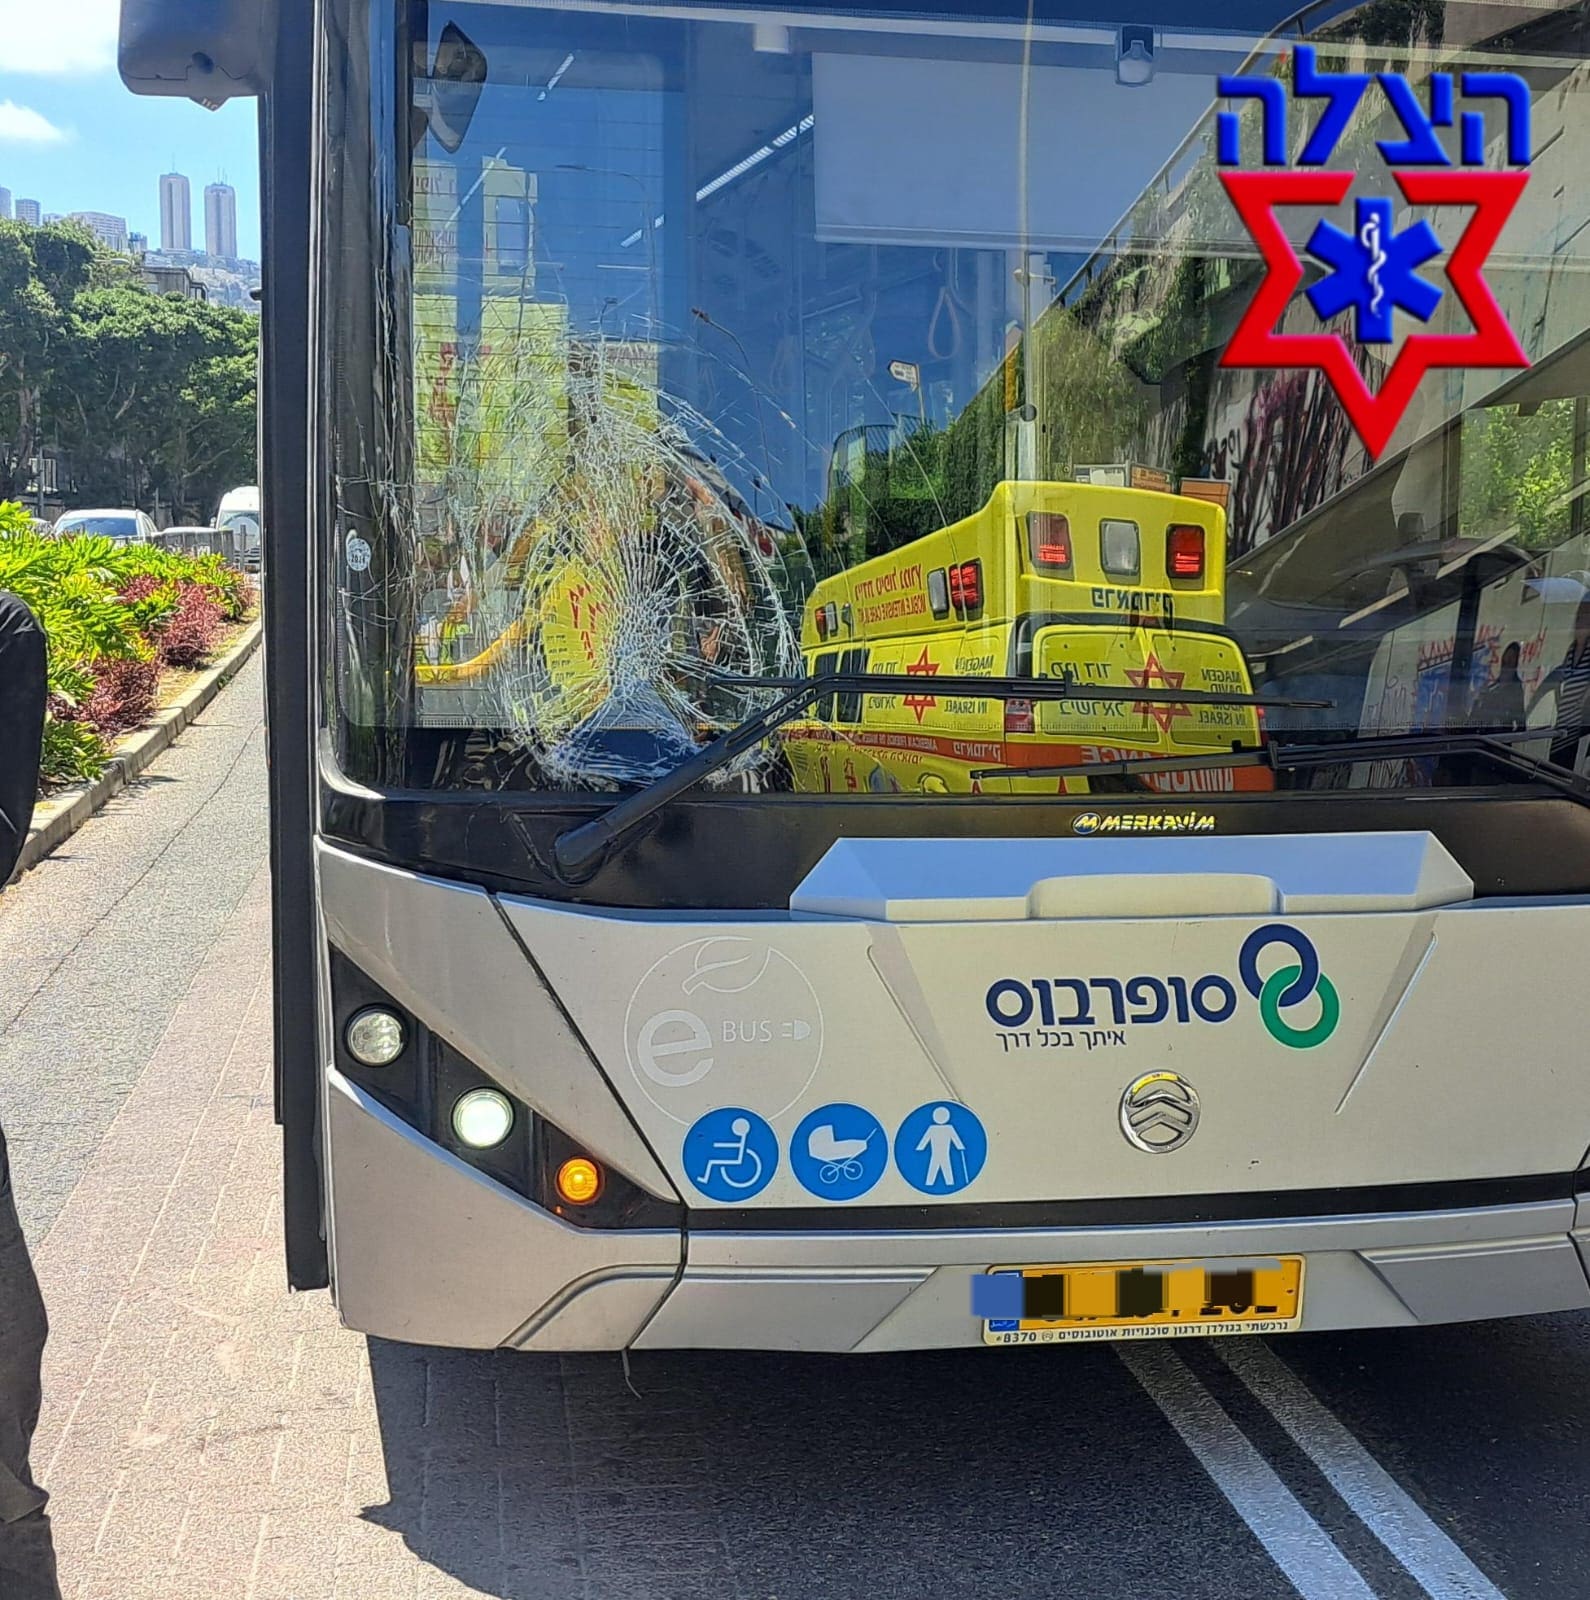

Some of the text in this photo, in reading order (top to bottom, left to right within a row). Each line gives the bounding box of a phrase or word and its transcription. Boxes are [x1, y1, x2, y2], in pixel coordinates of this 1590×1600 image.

[985, 974, 1237, 1028] סופרבוס
[636, 1009, 773, 1088] e BUS
[996, 1028, 1126, 1052] איתך בכל דרך
[1003, 1332, 1037, 1343] 8370
